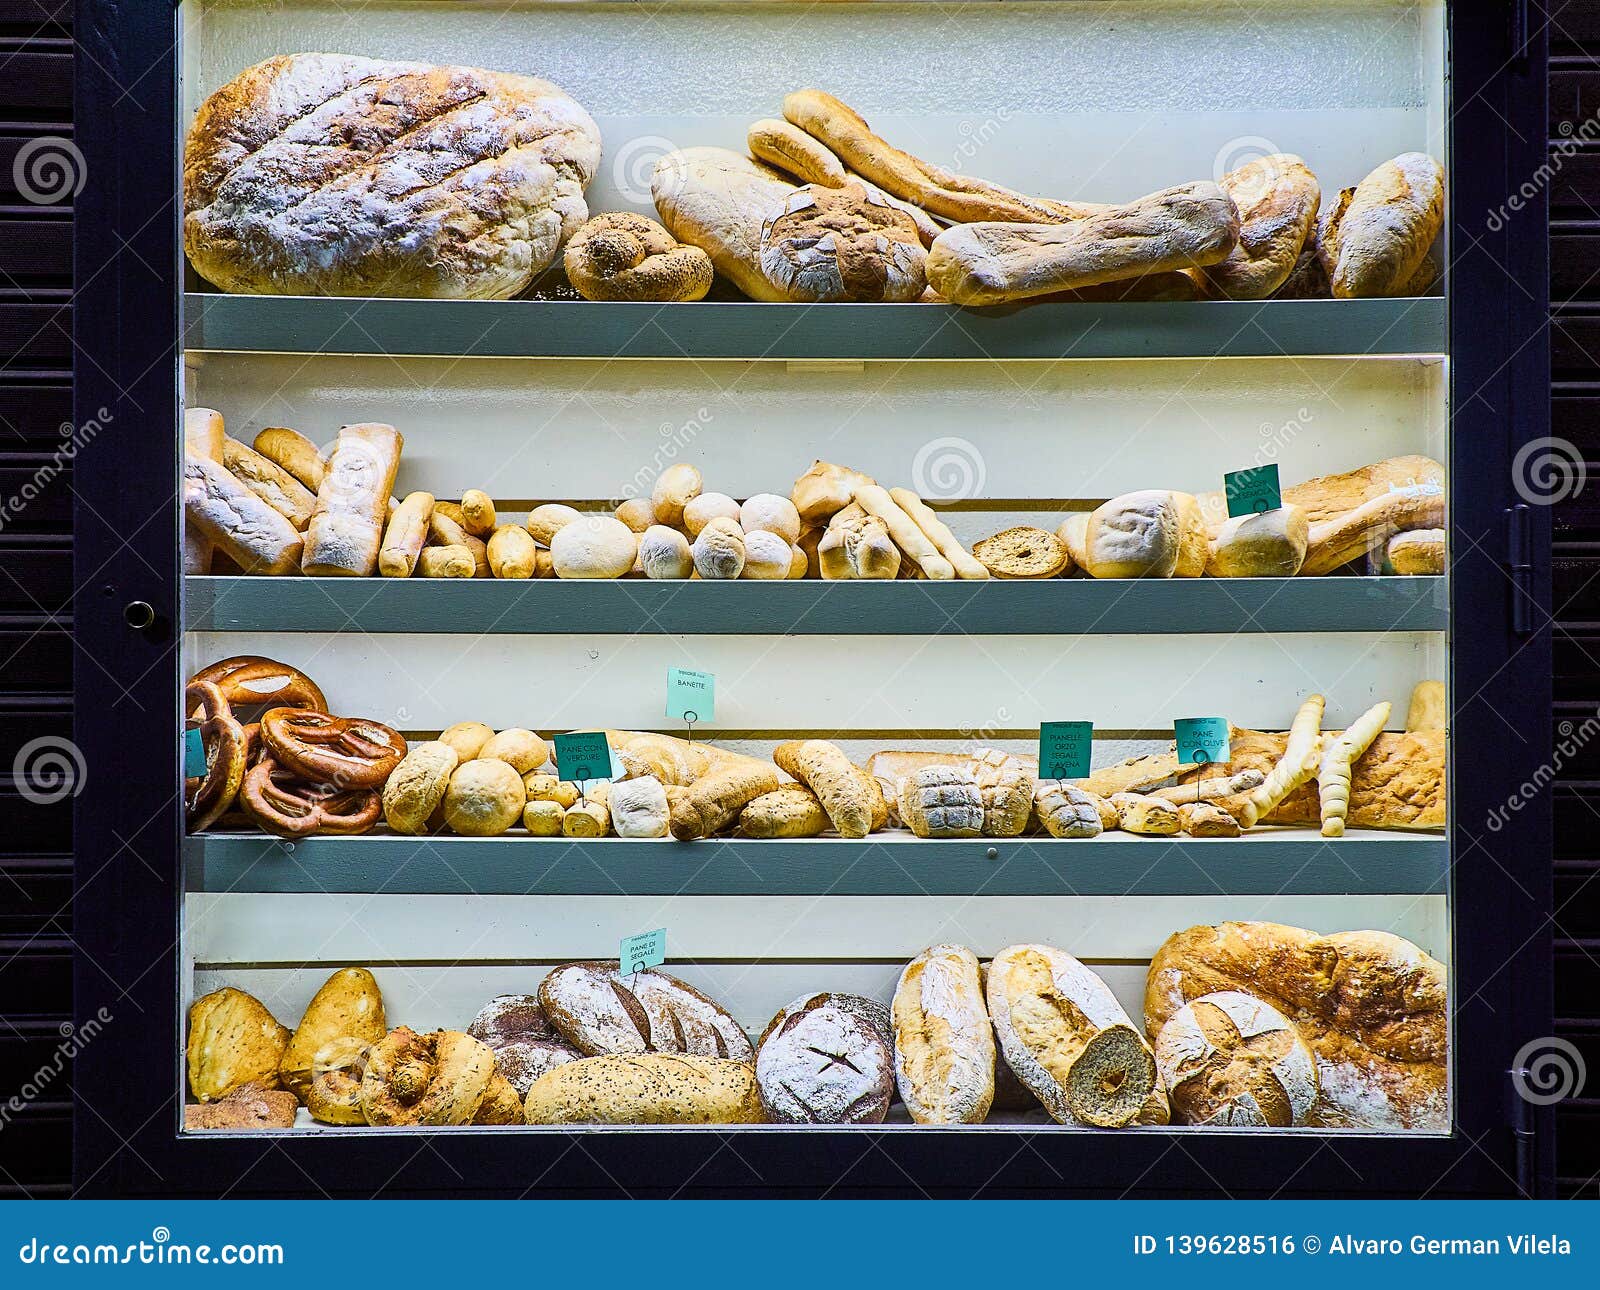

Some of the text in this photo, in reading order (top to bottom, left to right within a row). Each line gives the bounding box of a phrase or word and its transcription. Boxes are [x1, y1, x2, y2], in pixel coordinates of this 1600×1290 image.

[677, 679, 705, 690] BANETTE
[1192, 730, 1214, 738] PANE
[561, 744, 604, 753] PANE CON
[1182, 740, 1202, 748] CON
[566, 753, 601, 762] VERDURE
[630, 940, 656, 953] PANE DI
[630, 948, 655, 961] SEGALE
